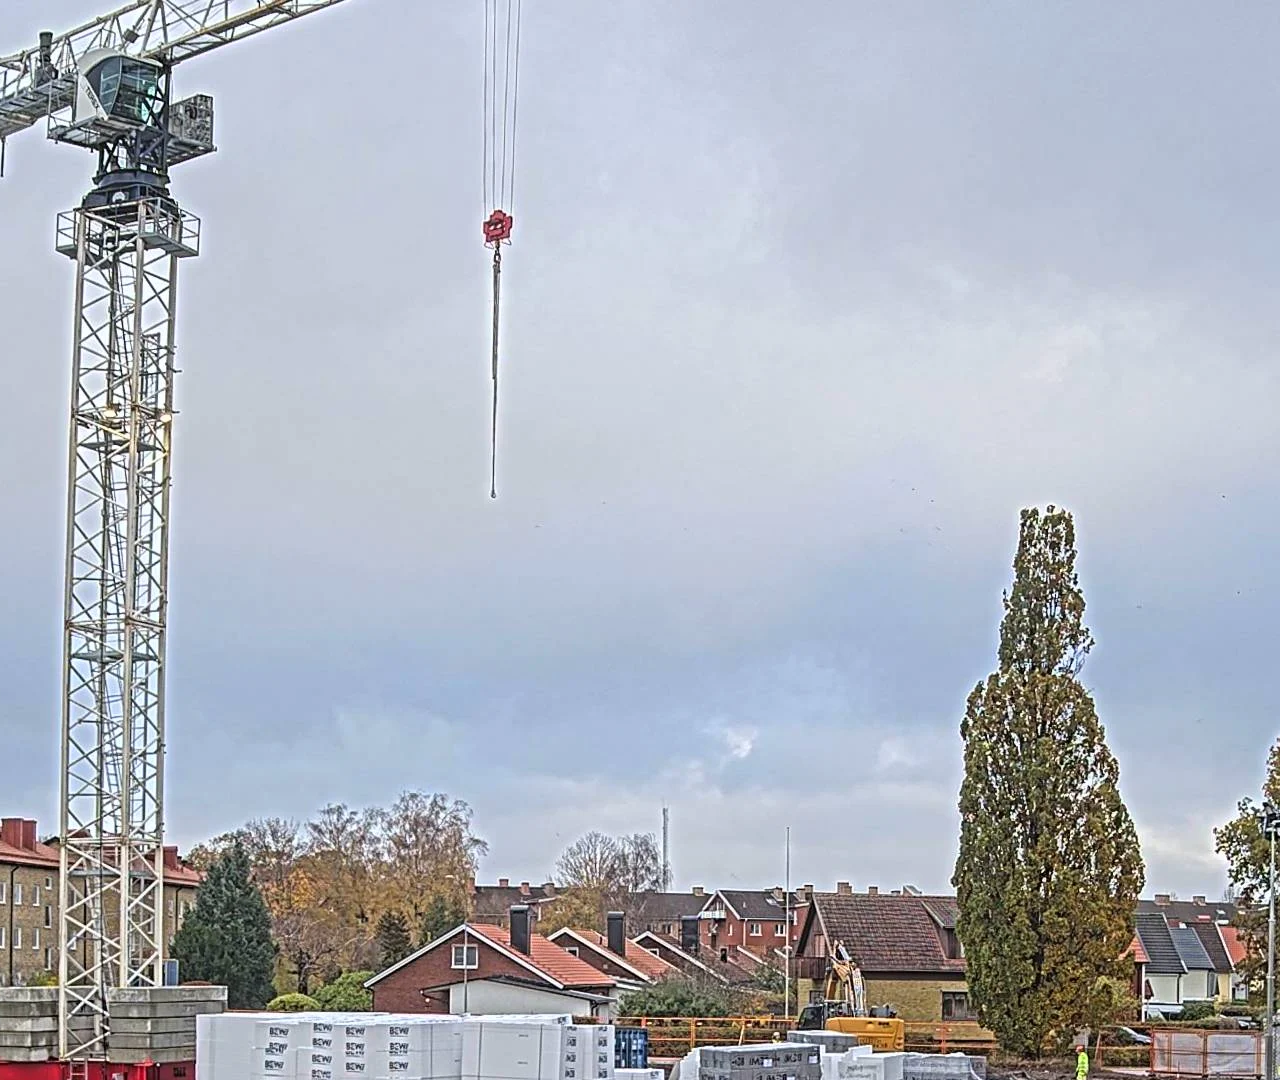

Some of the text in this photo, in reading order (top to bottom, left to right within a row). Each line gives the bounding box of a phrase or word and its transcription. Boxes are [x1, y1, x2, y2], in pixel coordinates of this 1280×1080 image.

[346, 1027, 365, 1035] BEWI
[389, 1026, 409, 1035] BEWI
[312, 1038, 332, 1047] BEWI
[312, 1054, 332, 1064] BEWI
[346, 1062, 365, 1071] BEWI
